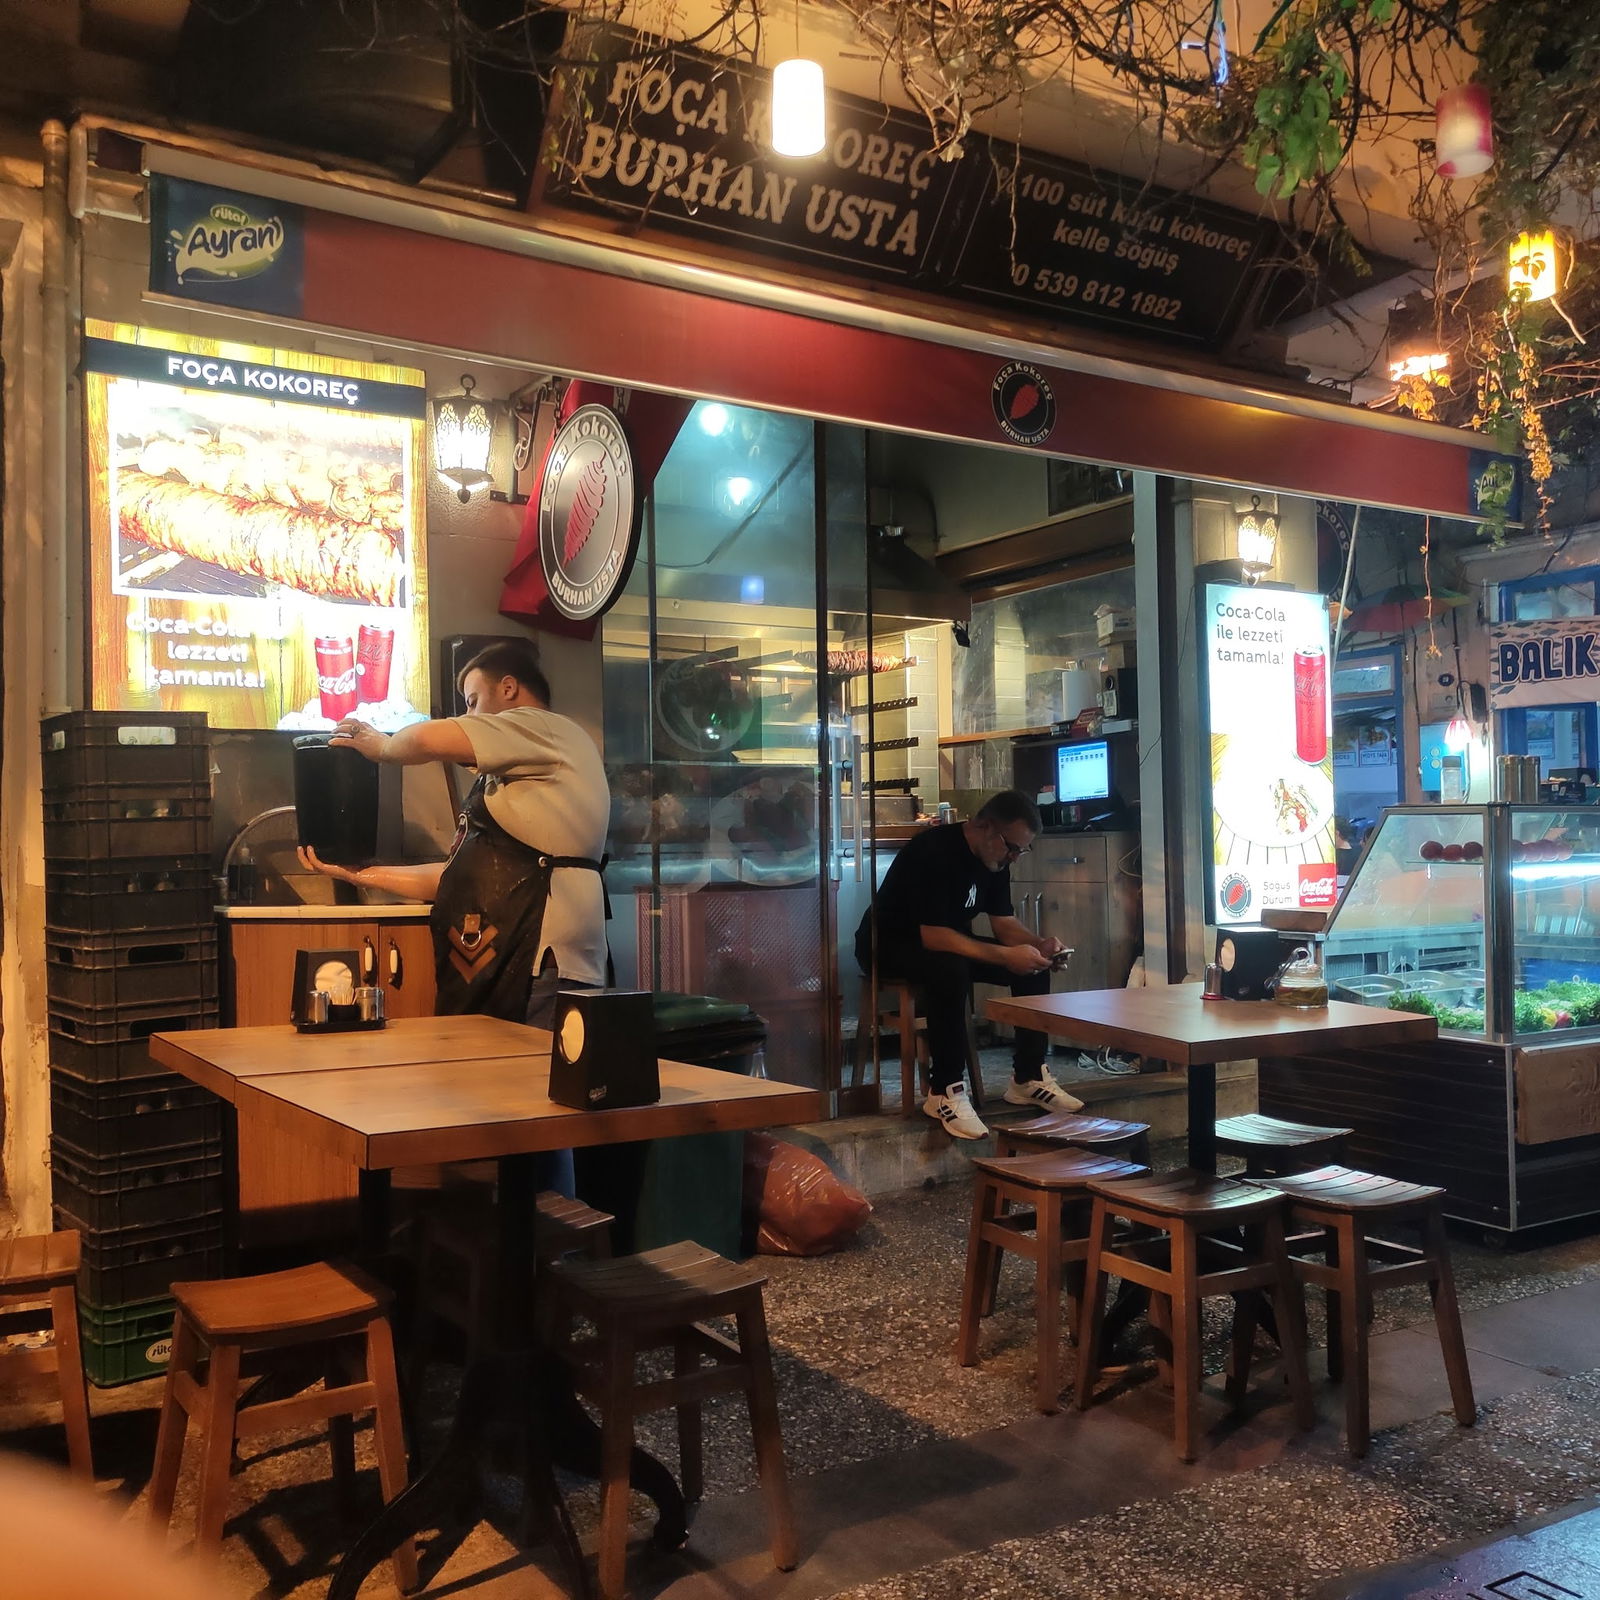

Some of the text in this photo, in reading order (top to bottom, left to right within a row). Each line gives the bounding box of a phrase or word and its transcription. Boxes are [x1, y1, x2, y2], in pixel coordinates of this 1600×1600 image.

[608, 61, 936, 200] FOÇA KOREÇ
[577, 122, 919, 256] BURHAN USTA
[188, 225, 275, 259] Ayran
[1053, 219, 1180, 276] kelle söğüş
[1067, 192, 1109, 217] süt
[1168, 216, 1251, 261] kokoreç
[1013, 264, 1182, 321] 0 539 812 1882
[168, 356, 359, 404] FOÇA KOKOREÇ
[993, 366, 1014, 391] Foça
[1001, 420, 1050, 443] BURHAN USTA
[551, 549, 623, 606] BURHAN USTA
[1216, 624, 1284, 643] ile lezzeti
[1217, 647, 1285, 665] tamamla!
[1499, 634, 1599, 684] BALIK
